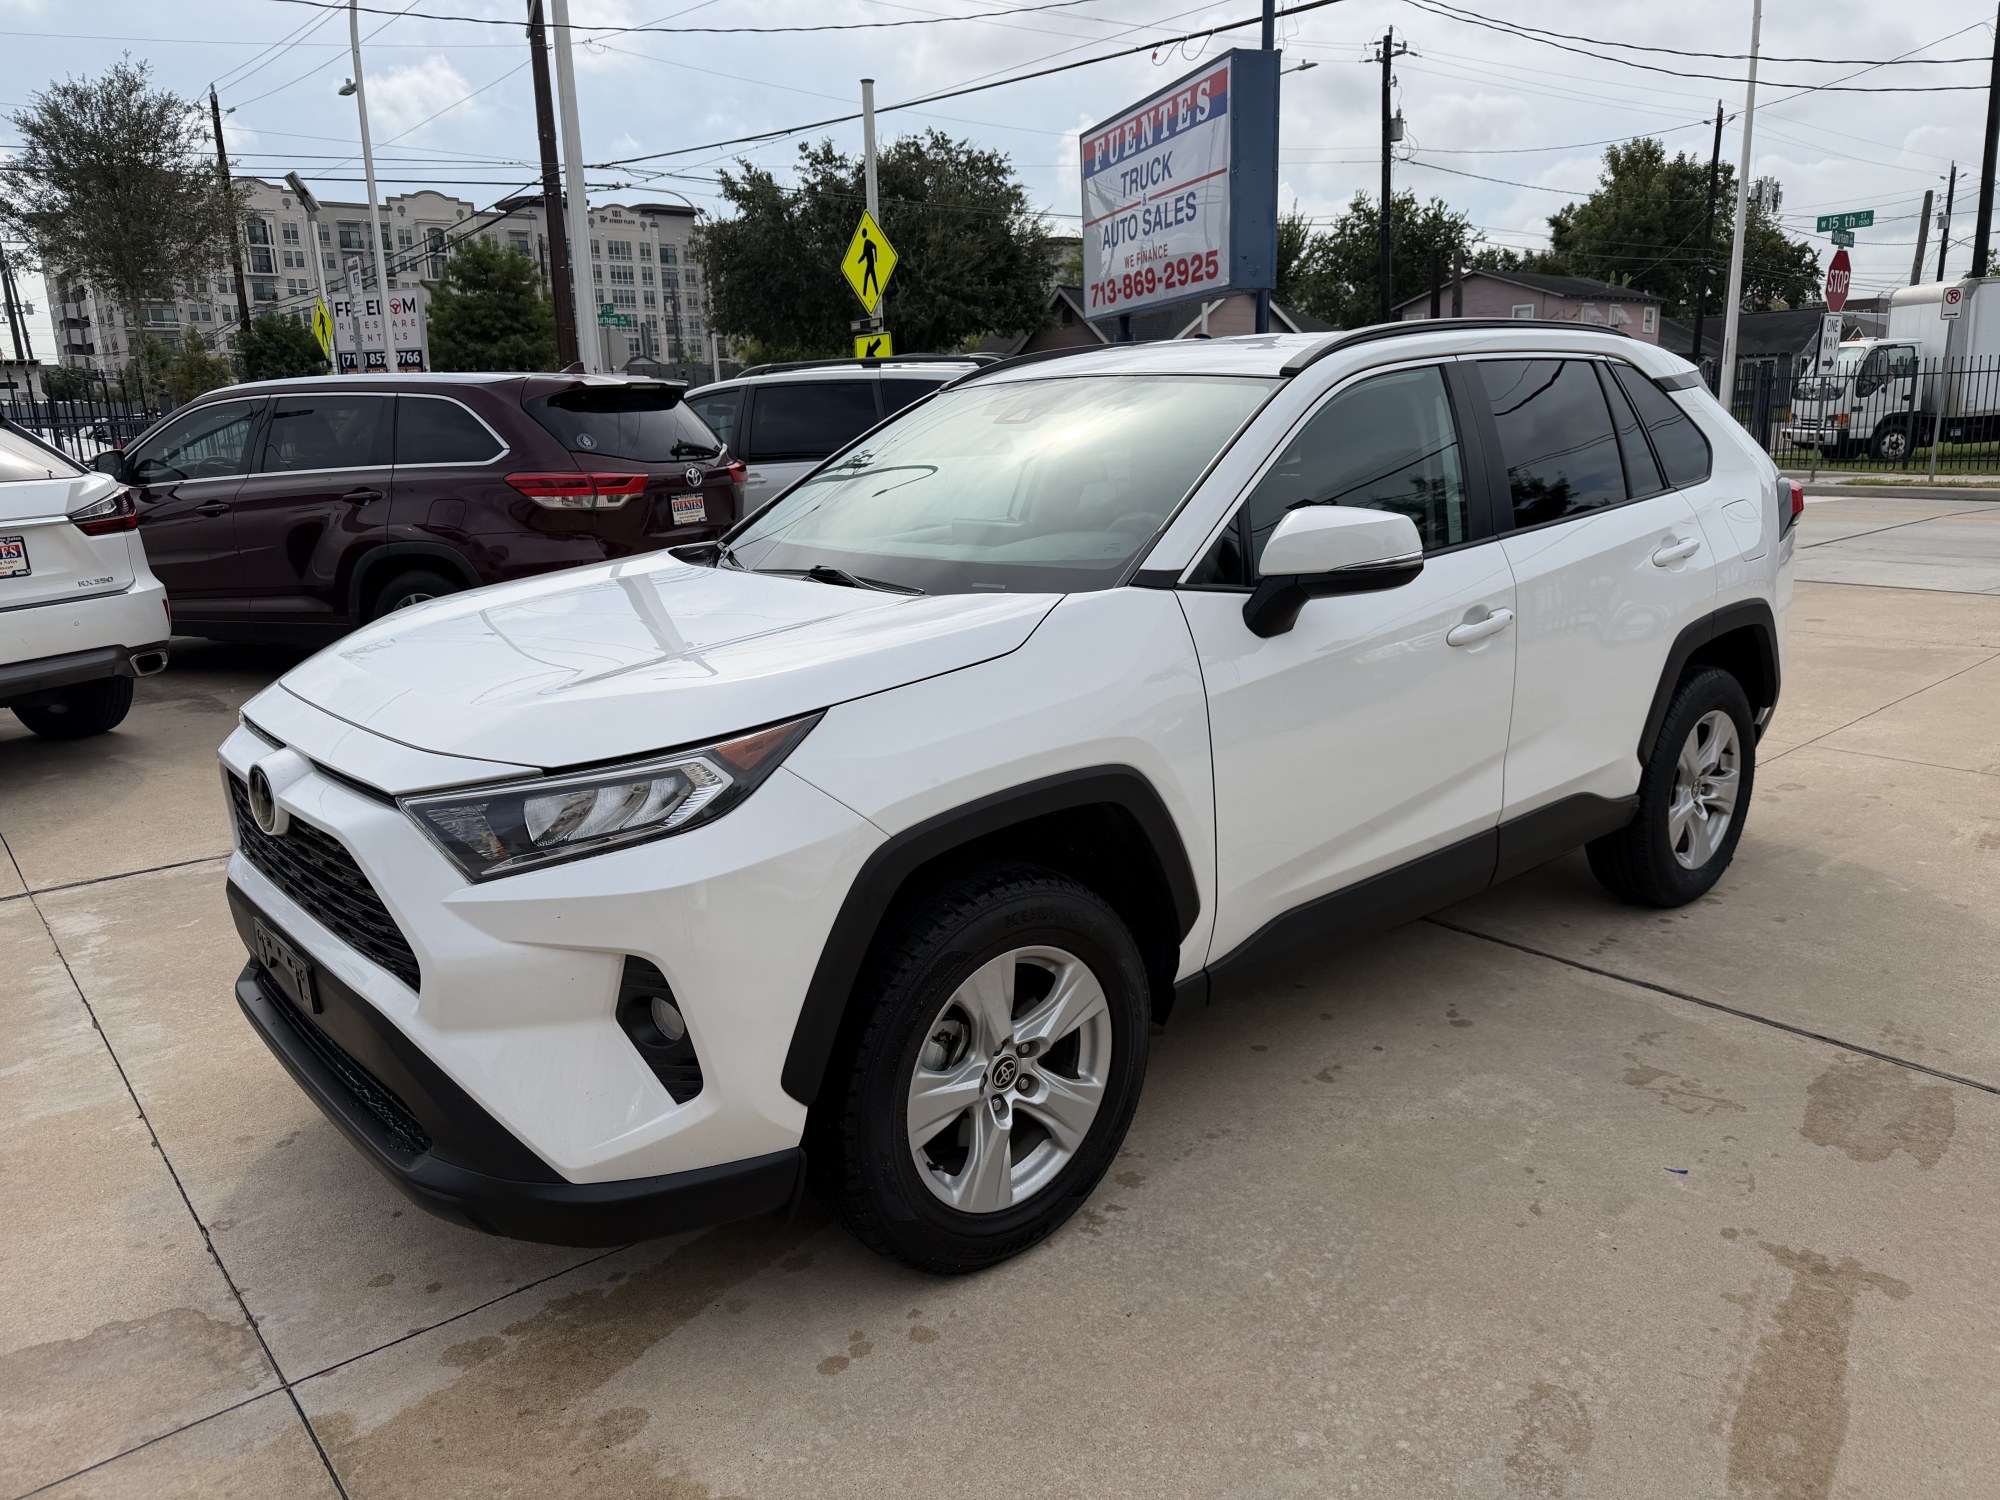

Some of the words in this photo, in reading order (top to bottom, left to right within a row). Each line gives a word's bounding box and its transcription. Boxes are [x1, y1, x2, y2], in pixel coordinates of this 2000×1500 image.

[1094, 80, 1211, 171] FUENTES
[1120, 151, 1173, 198] TRUCK
[1142, 193, 1147, 207] &
[1102, 214, 1138, 250] AUTO
[1142, 191, 1197, 236] SALES
[1821, 220, 1827, 228] W
[1828, 216, 1839, 229] 15
[1844, 215, 1856, 227] th
[1124, 254, 1135, 269] WE
[1137, 243, 1169, 266] FINANCE
[1090, 249, 1219, 308] 713-869-2925
[1827, 269, 1850, 294] STOP
[1826, 319, 1839, 333] ONE
[1823, 336, 1839, 350] WAY
[341, 353, 367, 367] (71)
[674, 501, 701, 511] FUENTES
